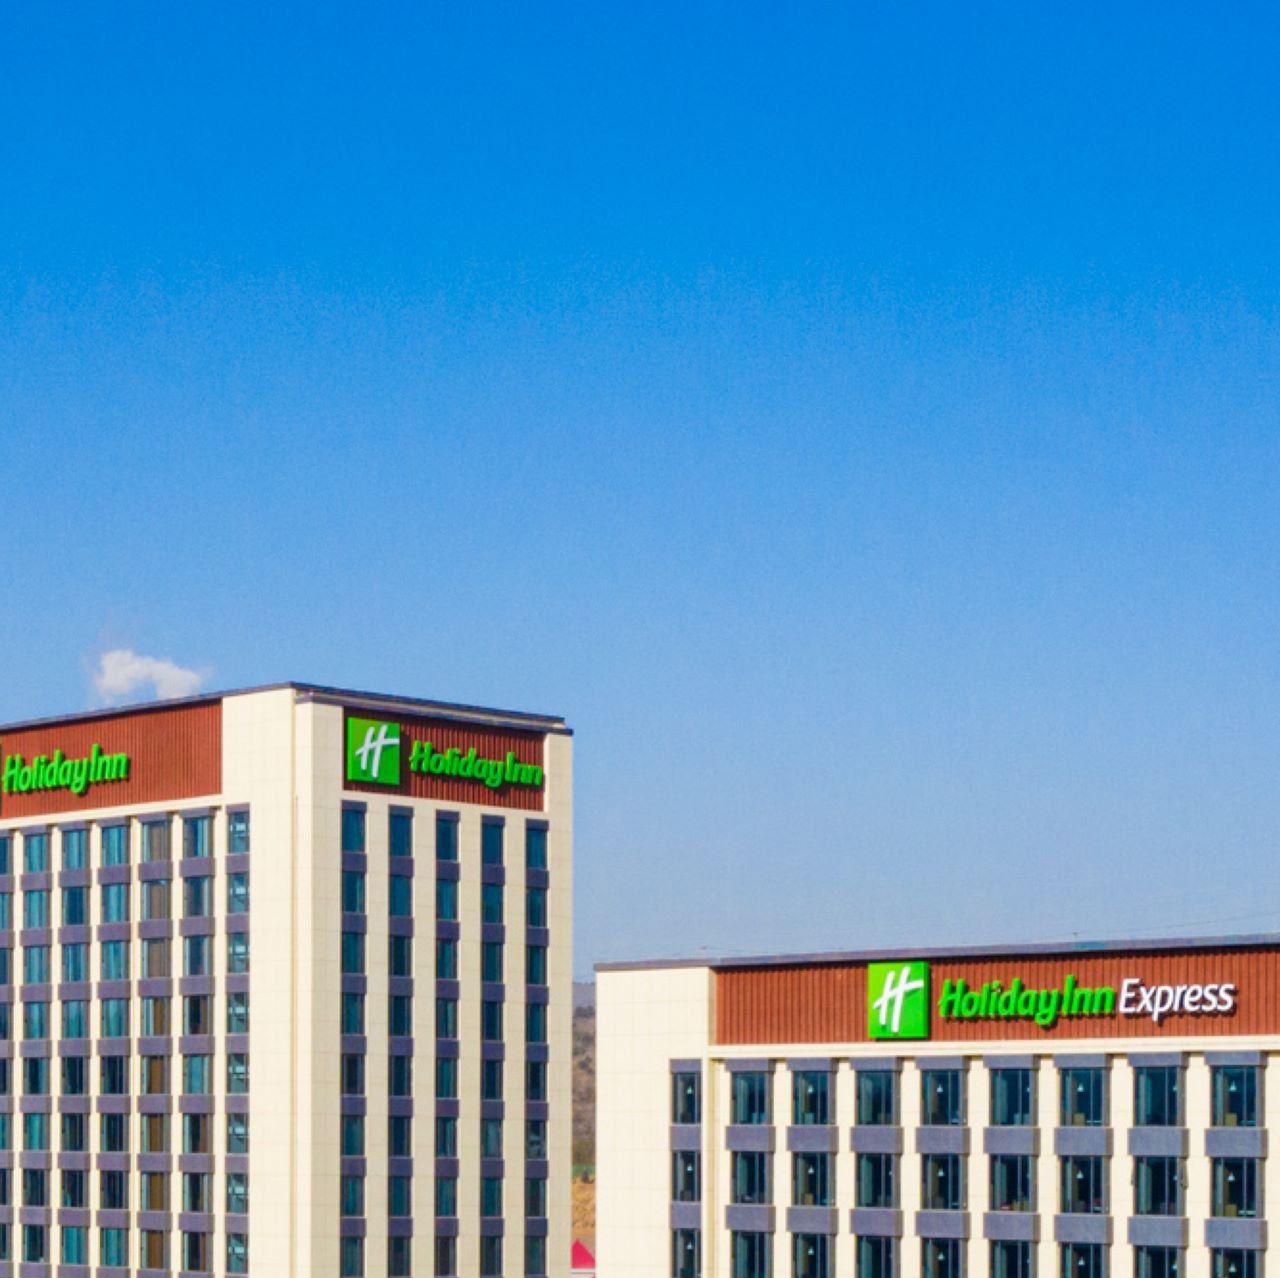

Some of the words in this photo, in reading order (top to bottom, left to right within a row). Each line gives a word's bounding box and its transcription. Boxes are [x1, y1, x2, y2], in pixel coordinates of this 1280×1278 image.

[2, 748, 88, 794] Holiday
[89, 743, 128, 782] Inn
[409, 740, 503, 788] Holiday
[504, 751, 543, 786] Inn
[938, 978, 1060, 1025] Holiday
[1061, 974, 1116, 1015] Inn
[1118, 977, 1236, 1024] Express
